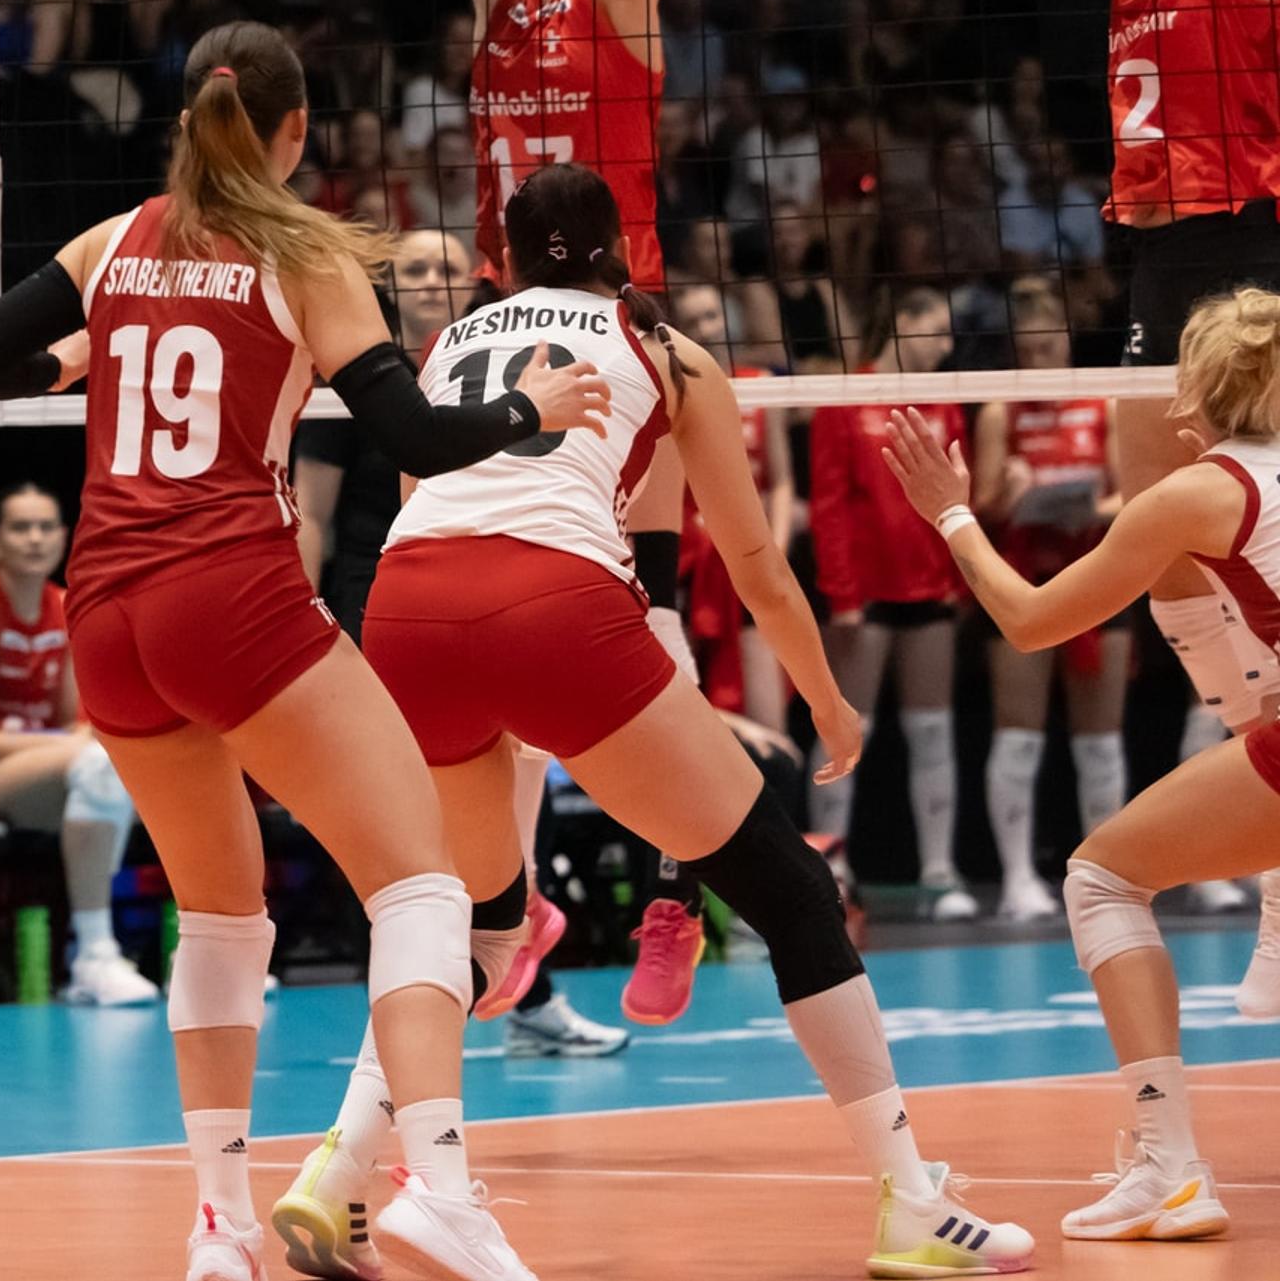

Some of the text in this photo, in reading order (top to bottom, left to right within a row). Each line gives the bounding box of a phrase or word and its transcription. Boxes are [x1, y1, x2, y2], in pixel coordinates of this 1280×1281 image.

[488, 88, 592, 117] Mobiliar
[1115, 58, 1164, 149] 2
[444, 305, 609, 350] NESIMOVIĆ
[108, 324, 224, 480] 19
